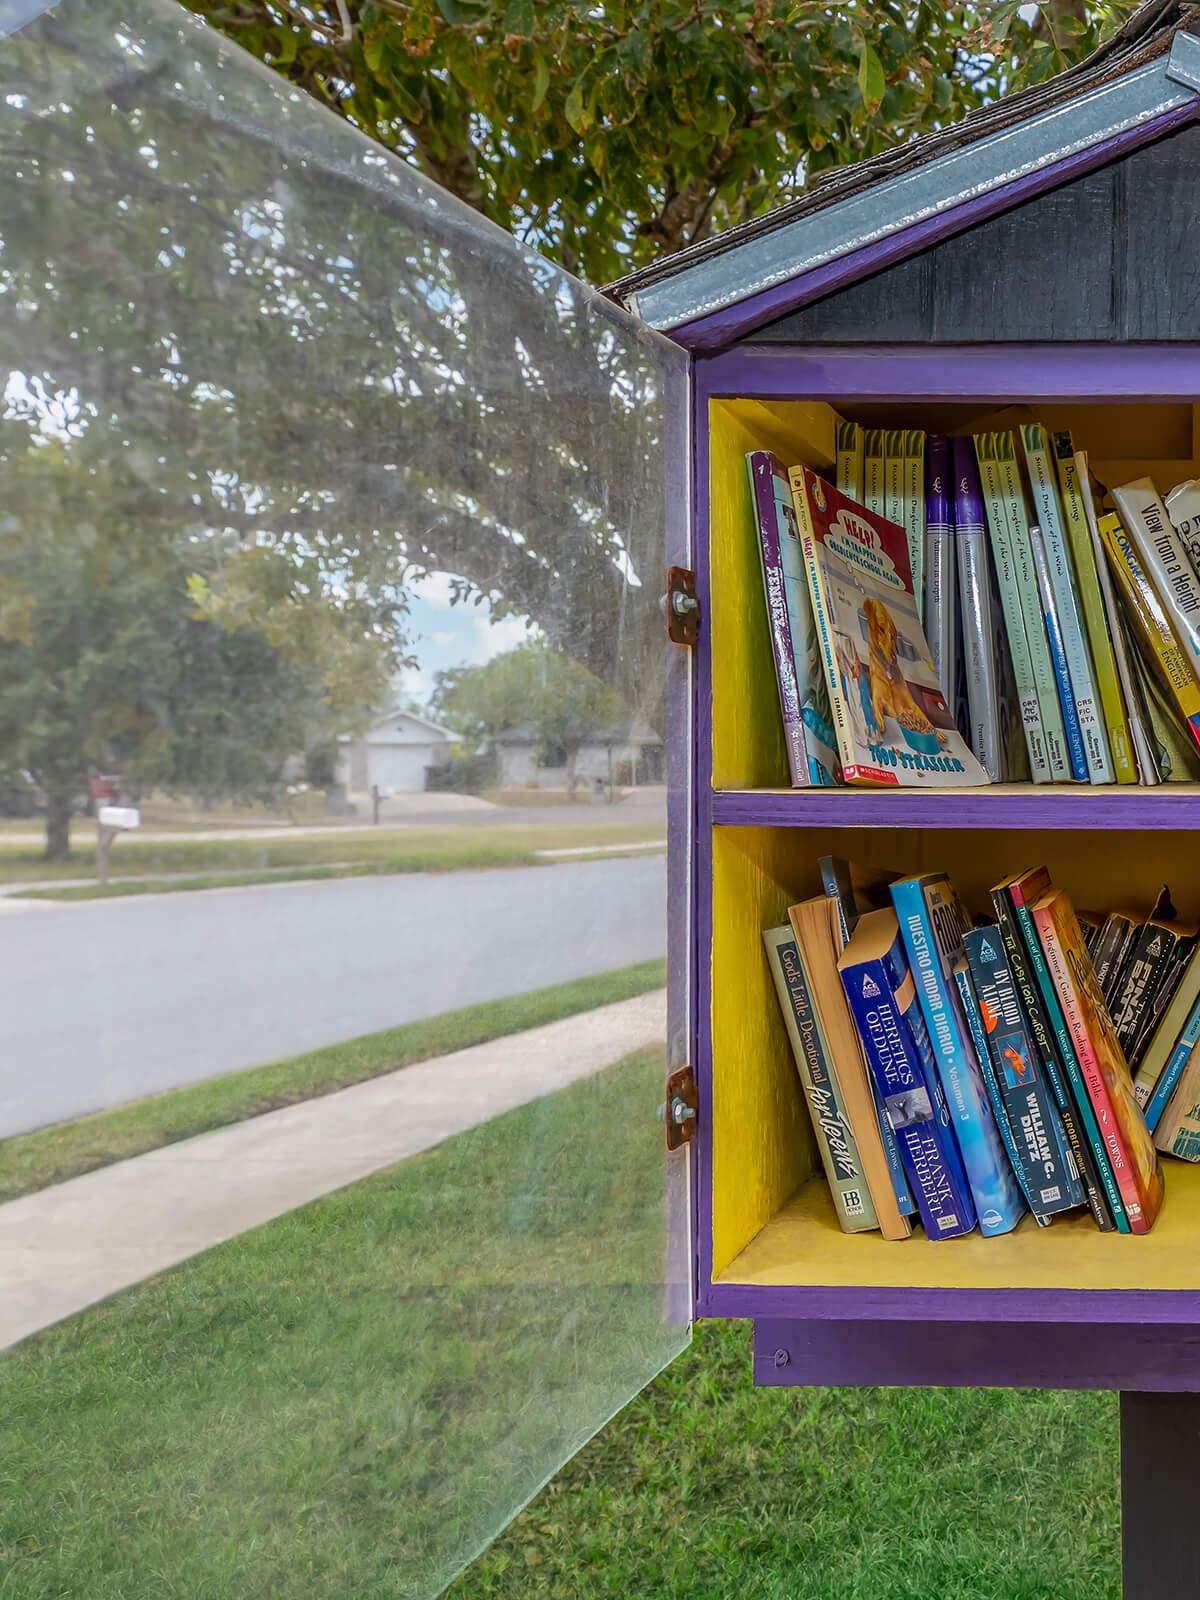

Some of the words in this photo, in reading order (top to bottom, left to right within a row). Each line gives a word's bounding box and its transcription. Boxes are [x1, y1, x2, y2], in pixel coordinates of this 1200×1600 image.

[1064, 465, 1080, 522] Dragonwings
[843, 516, 875, 549] HELP!
[1052, 539, 1060, 553] the
[1141, 503, 1164, 534] View
[1154, 535, 1176, 565] from
[1167, 564, 1182, 575] a
[829, 539, 860, 565] OBEDIENCE
[860, 559, 882, 576] SCHOOL
[882, 570, 900, 586] AGAIN
[851, 542, 876, 562] TRAPPED
[877, 556, 884, 567] IN
[1000, 546, 1008, 559] the
[1019, 546, 1027, 559] the
[766, 565, 785, 628] TENNEY
[802, 536, 814, 559] HELP!
[811, 573, 822, 601] TRAPPED
[817, 609, 828, 642] OBEDIENCE
[823, 643, 832, 666] SCHOOL
[828, 667, 837, 689] AGAIN
[1161, 651, 1183, 689] ENGLISH
[1171, 656, 1190, 687] AMERICAN
[834, 697, 844, 727] STRASSER
[1022, 699, 1038, 708] CRS
[1065, 696, 1075, 715] SIETE
[1077, 698, 1093, 707] CRS
[1079, 707, 1091, 715] FIC
[1069, 716, 1078, 731] LAS
[1081, 716, 1095, 724] STA
[978, 723, 986, 750] Prentice
[868, 743, 897, 766] TODD
[899, 751, 966, 773] STRASSER
[1042, 925, 1050, 933] A
[1023, 920, 1034, 945] Person
[1033, 953, 1043, 973] Jesus
[1045, 933, 1065, 980] Beginner's
[782, 950, 801, 984] God's
[993, 969, 1010, 985] BY
[1005, 934, 1017, 950] THE
[1022, 984, 1035, 1005] FOR
[791, 987, 809, 1017] Little
[981, 984, 1005, 1020] ALONE
[998, 987, 1021, 1026] BLOOD
[1060, 981, 1072, 1009] Guide
[866, 1011, 883, 1035] OF
[1068, 1009, 1076, 1021] to
[1128, 1001, 1146, 1035] THE
[1189, 1020, 1200, 1037] canta
[800, 1021, 828, 1084] Devotional
[878, 1003, 914, 1085] HERETICS
[1058, 1029, 1068, 1052] Moore
[1072, 1022, 1089, 1057] Reading
[873, 1036, 899, 1085] DUNE
[933, 1012, 955, 1055] DIARIO
[949, 1066, 964, 1112] Volumen
[961, 1113, 970, 1121] 3
[1083, 1059, 1092, 1074] the
[1171, 1052, 1186, 1077] Meindert
[806, 1085, 833, 1118] for
[1089, 1075, 1100, 1098] Bible
[1135, 1086, 1149, 1097] CRS
[1160, 1076, 1176, 1099] DaJong
[819, 1111, 859, 1179] Teens
[1020, 1116, 1041, 1162] DIETZ
[1025, 1092, 1051, 1161] WILLIAM
[1044, 1160, 1055, 1180] C.
[1106, 1132, 1125, 1169] TOWNS
[905, 1131, 944, 1216] HERBERT
[921, 1137, 955, 1201] FRANK
[1094, 1142, 1108, 1178] COLLEGE
[1106, 1179, 1119, 1205] PRESS
[843, 1191, 860, 1207] HB
